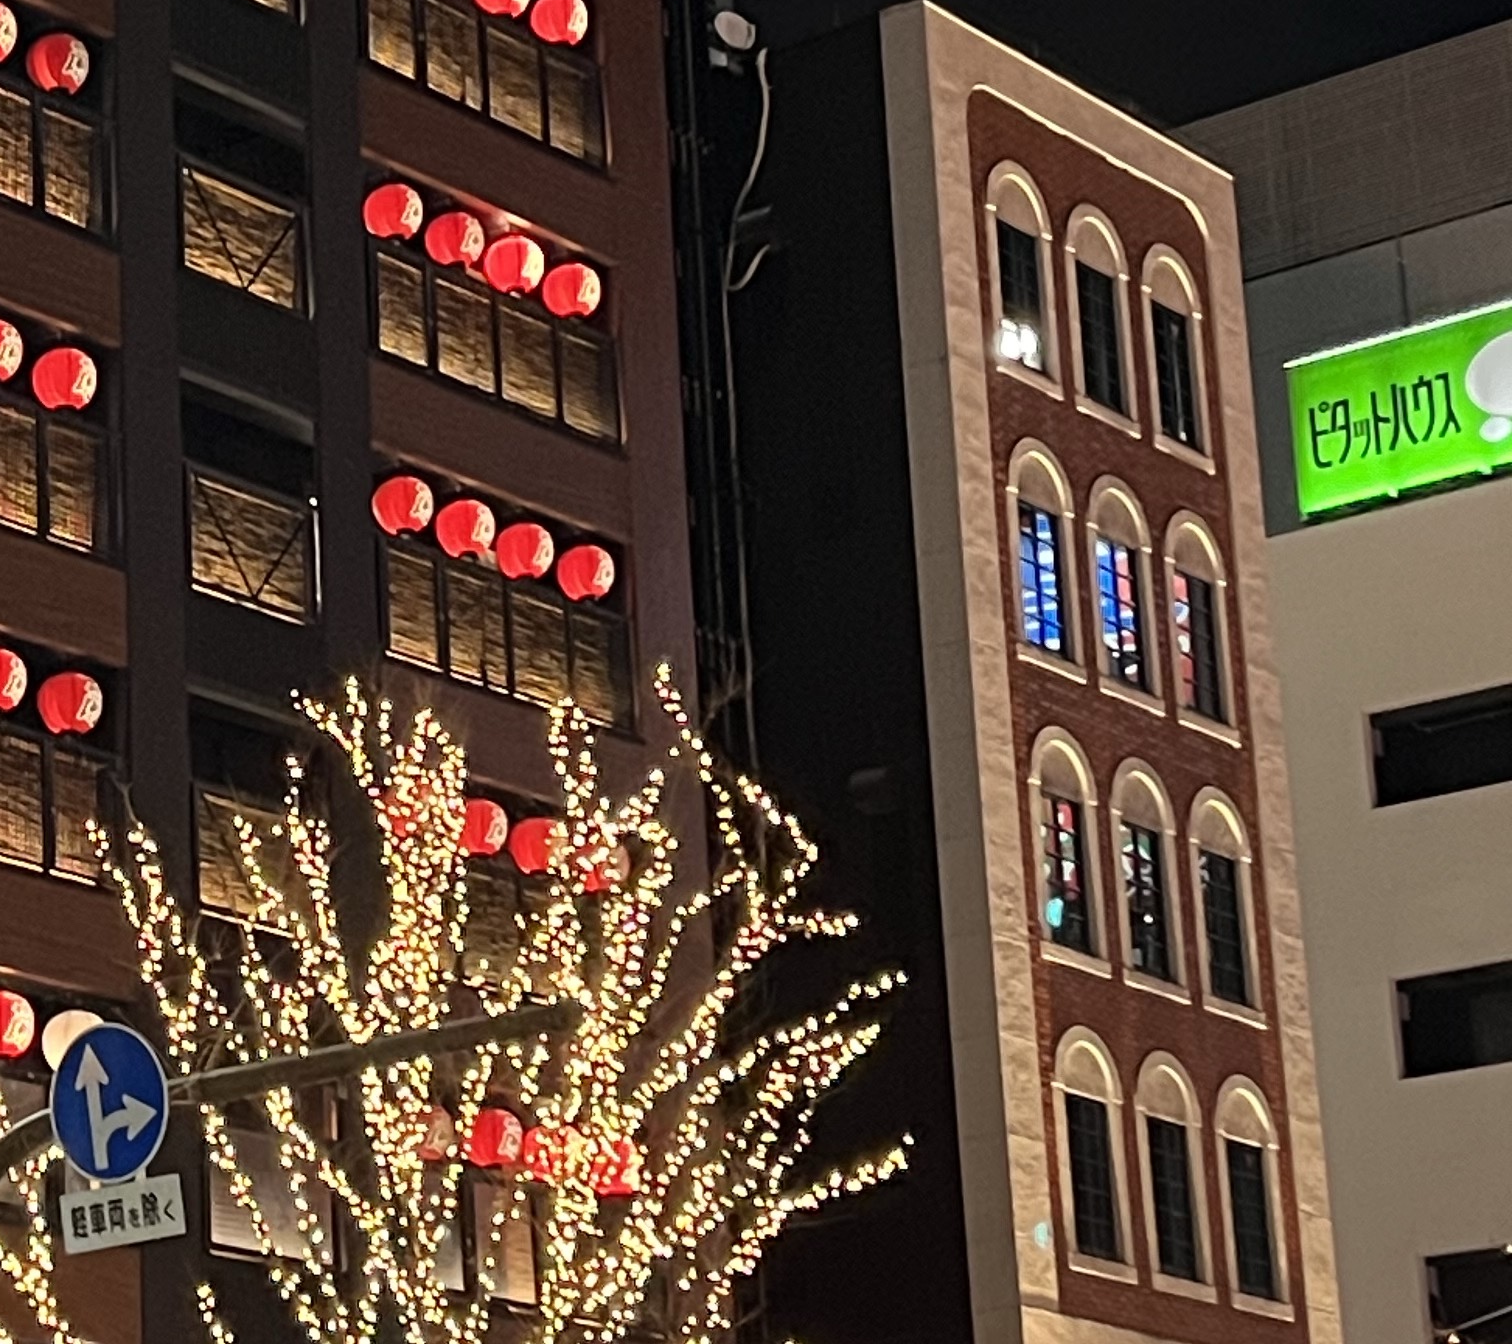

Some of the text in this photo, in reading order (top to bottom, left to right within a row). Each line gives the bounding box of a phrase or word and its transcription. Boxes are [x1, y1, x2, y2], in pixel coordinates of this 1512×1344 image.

[1308, 372, 1462, 469] ピタットハウス
[71, 1192, 176, 1239] 軽車両を除く
